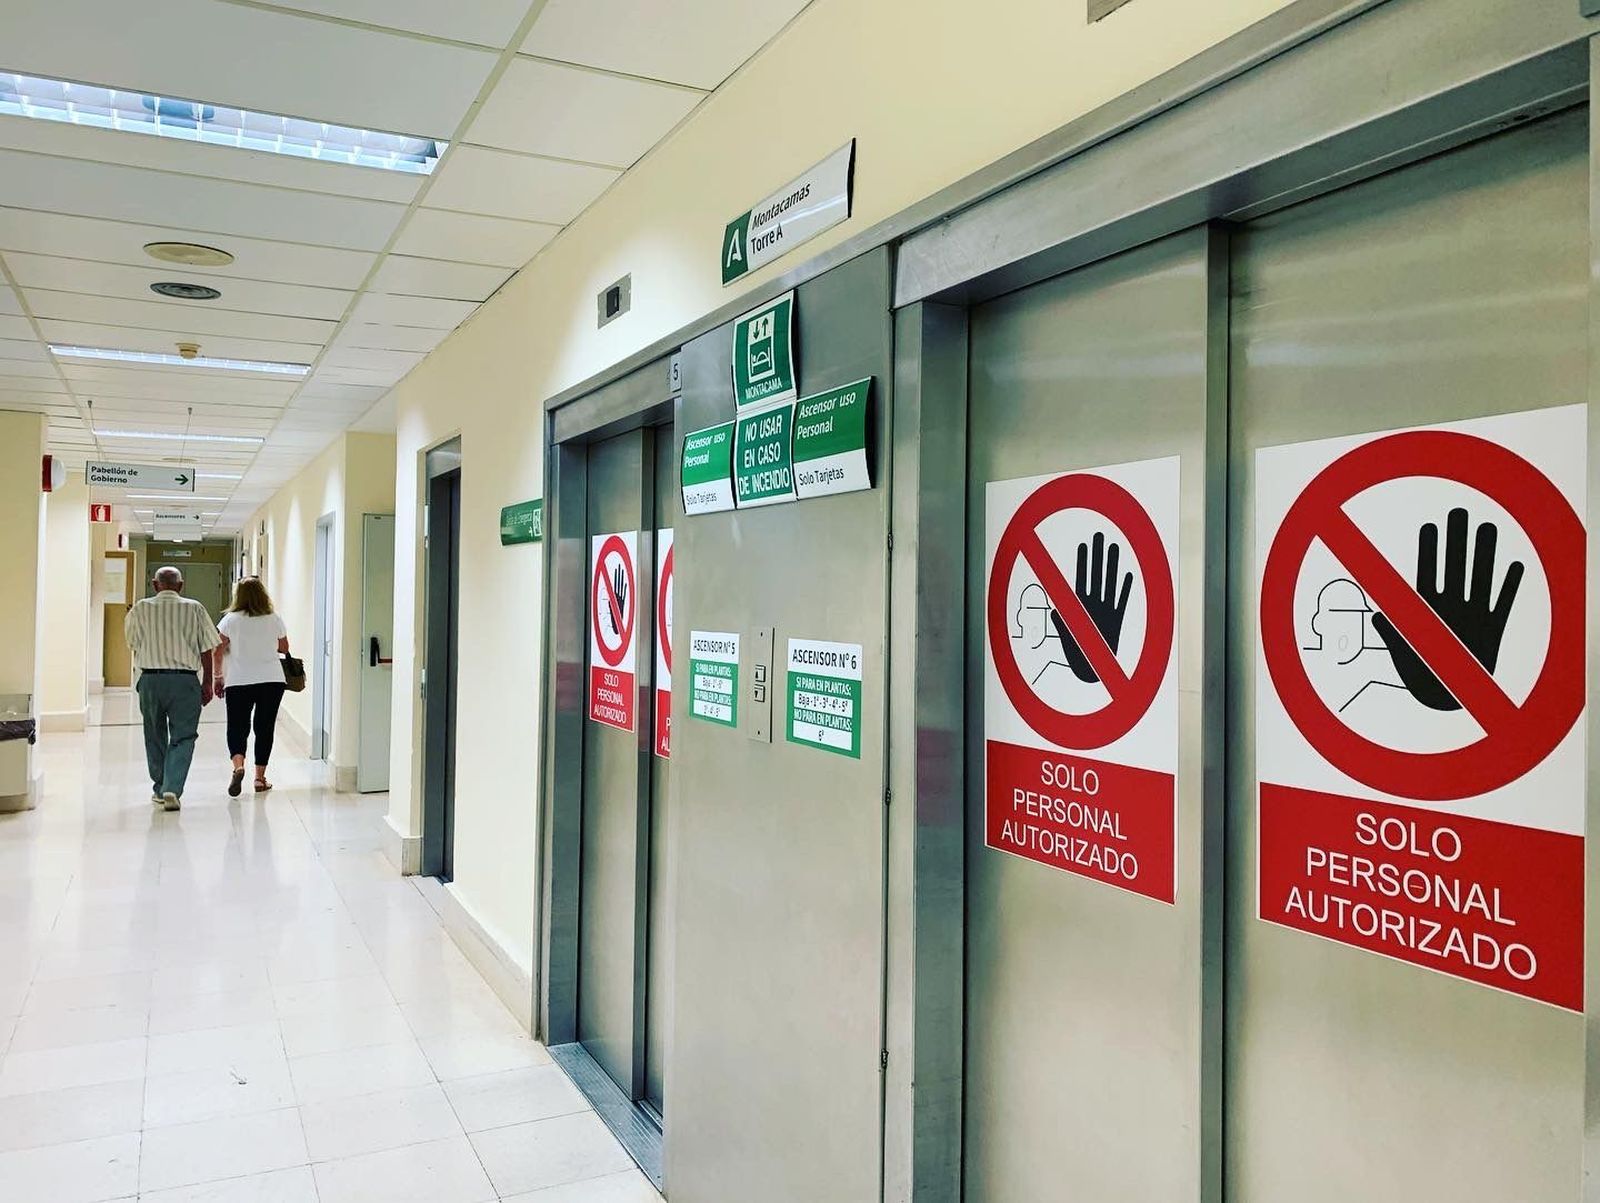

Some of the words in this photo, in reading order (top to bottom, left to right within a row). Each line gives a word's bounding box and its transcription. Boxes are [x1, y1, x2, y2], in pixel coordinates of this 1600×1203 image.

[752, 183, 811, 231] Montacamas
[726, 227, 743, 268] A
[751, 230, 774, 255] Torre
[775, 223, 783, 241] A
[673, 363, 679, 381] 5
[745, 377, 783, 400] MONTACAMA
[798, 397, 837, 420] Ascensor
[839, 391, 857, 408] uso
[744, 421, 758, 443] NO
[759, 414, 783, 439] USAR
[796, 415, 833, 441] Personal
[685, 434, 713, 451] Ascensor
[713, 431, 726, 445] uso
[684, 450, 710, 469] Personal
[744, 448, 755, 469] EN
[757, 441, 781, 466] CASO
[91, 466, 127, 476] Pabellón
[127, 468, 139, 476] de
[91, 474, 128, 484] Gobierno
[739, 476, 751, 496] DE
[751, 467, 790, 493] INCENDIO
[799, 471, 815, 487] Solo
[814, 467, 845, 486] Tarjetas
[686, 493, 697, 505] Solo
[693, 639, 723, 654] ASCENSOR
[731, 642, 736, 655] 5
[792, 648, 838, 668] ASCENSOR
[851, 654, 857, 670] 6
[603, 673, 619, 688] SOLO
[802, 677, 816, 691] PARA
[816, 679, 824, 692] EN
[824, 680, 852, 697] PLANTAS:
[597, 687, 625, 707] PERSONAL
[593, 703, 627, 724] AUTORIZADO
[801, 709, 816, 724] PARA
[816, 711, 825, 726] EN
[1040, 760, 1100, 795] SOLO
[1013, 787, 1128, 840] PERSONAL
[1355, 813, 1462, 862] SOLO
[1001, 819, 1139, 880] AUTORIZADO
[1306, 847, 1516, 926] PERSONAL
[1284, 886, 1538, 981] AUTORIZADO
